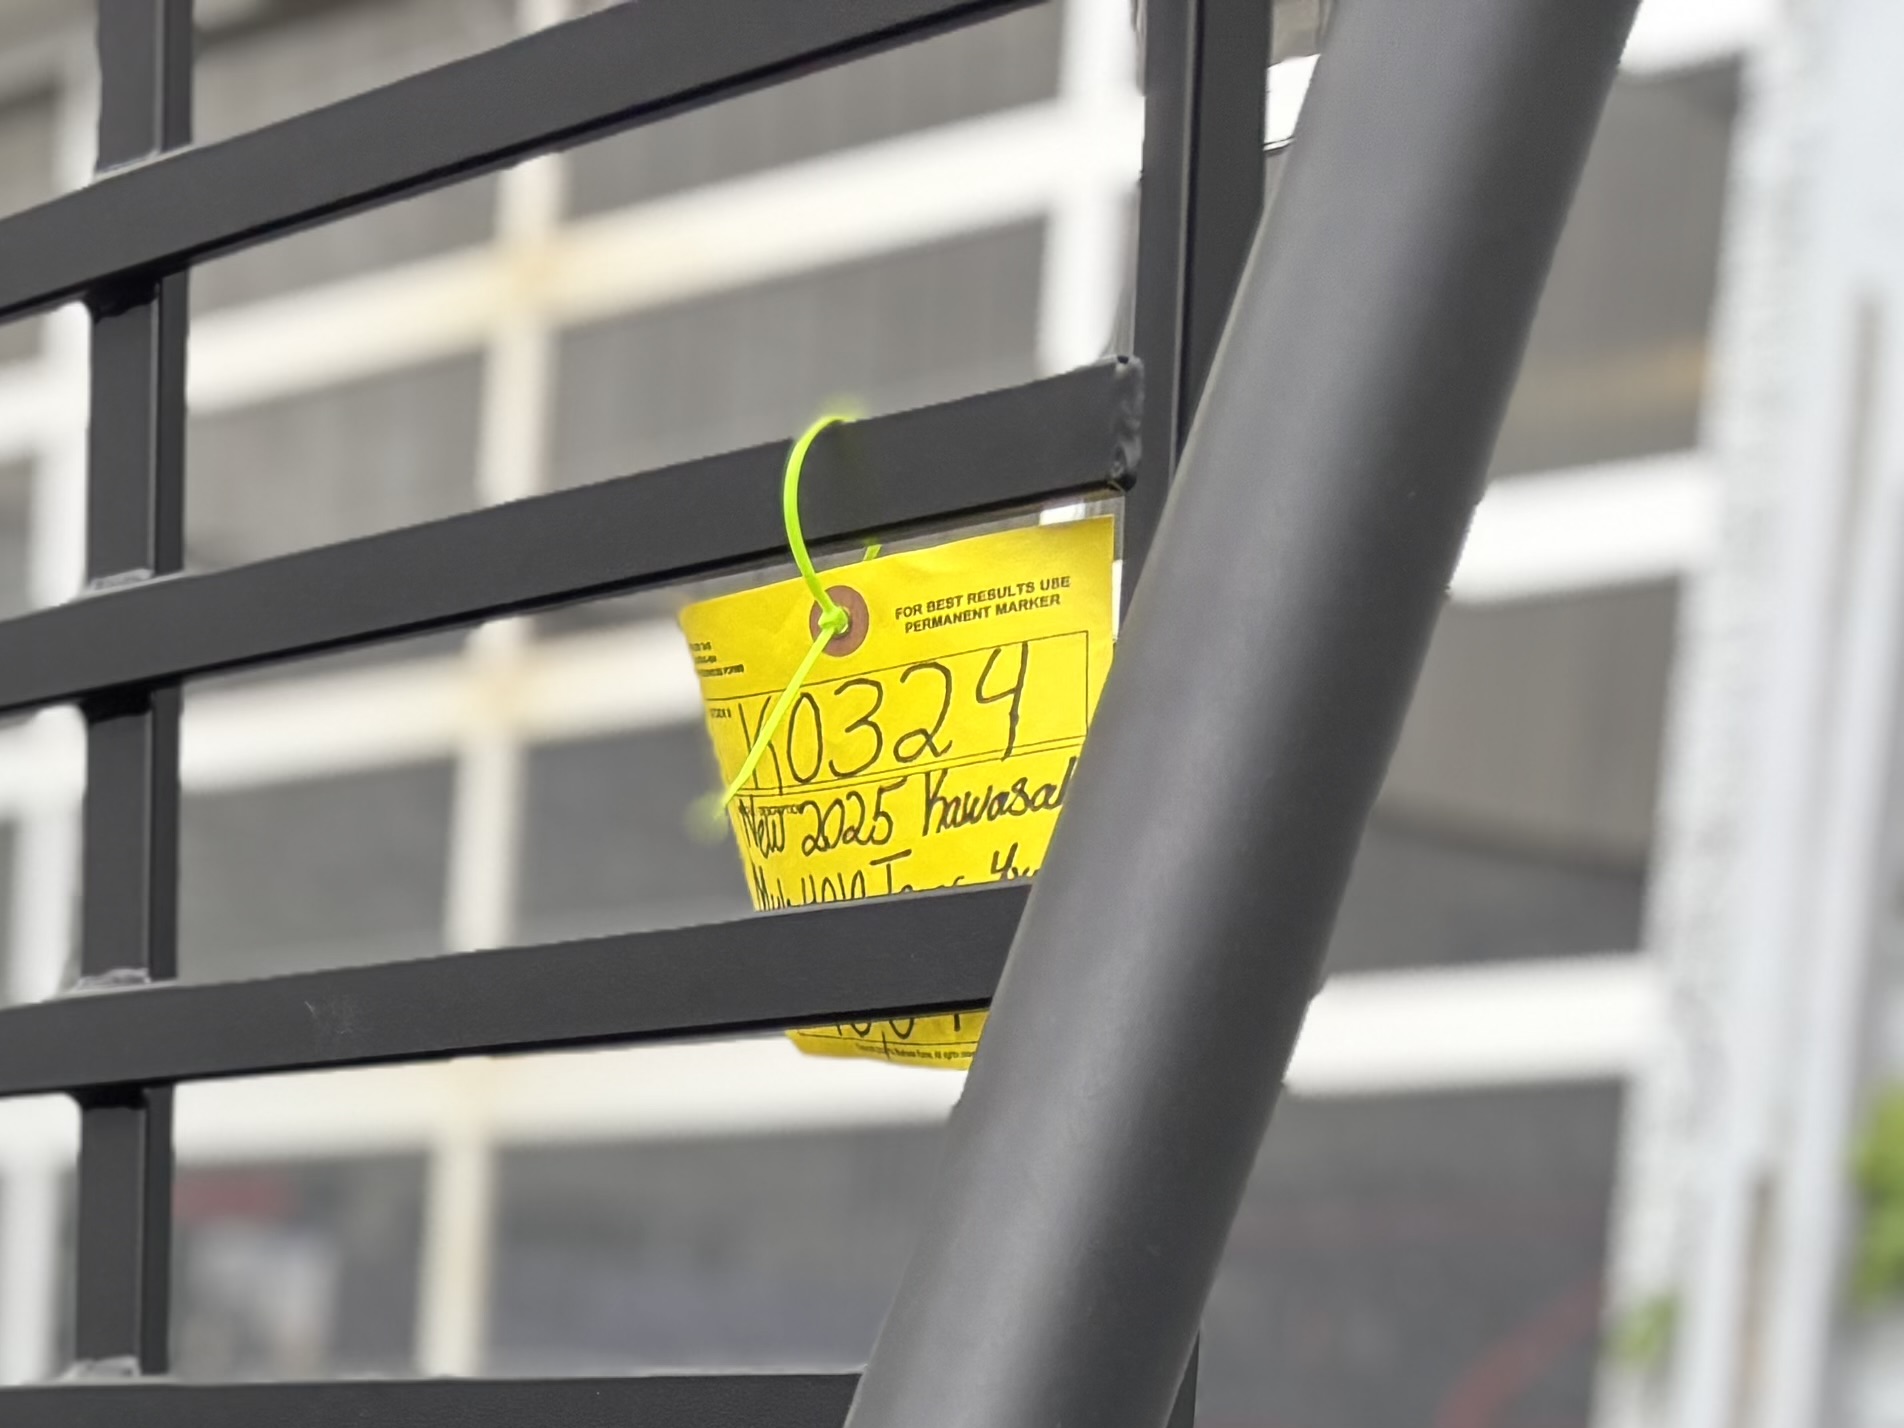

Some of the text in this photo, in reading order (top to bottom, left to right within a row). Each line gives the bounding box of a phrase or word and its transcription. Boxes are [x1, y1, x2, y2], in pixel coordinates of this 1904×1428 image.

[895, 575, 1071, 620] FOR BEST RESULTS USE
[904, 593, 1062, 634] PERMANENT MARKER
[737, 639, 1029, 796] K0324
[738, 794, 786, 859] New
[801, 776, 909, 857] 2025
